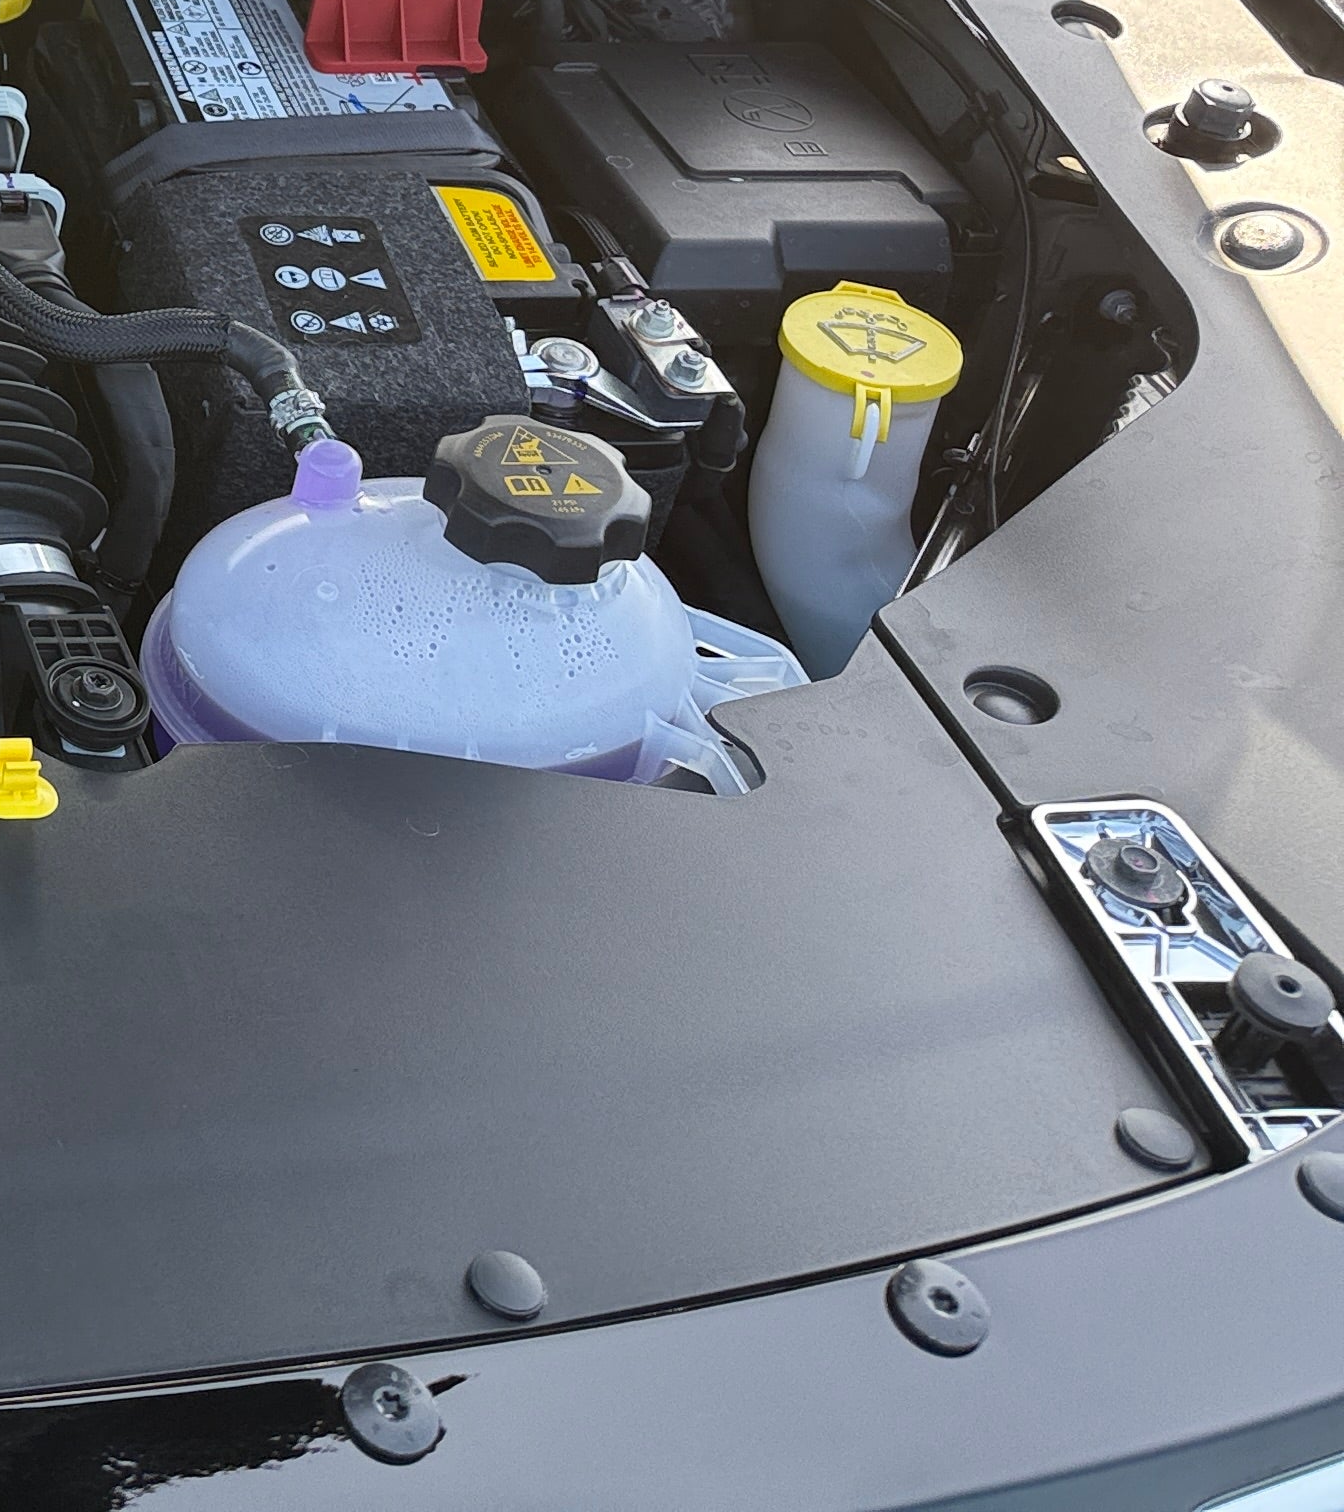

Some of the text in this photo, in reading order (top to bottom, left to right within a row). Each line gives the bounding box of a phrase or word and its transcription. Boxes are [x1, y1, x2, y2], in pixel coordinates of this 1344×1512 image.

[453, 198, 475, 226] BATTERY
[482, 209, 517, 260] NON-SPILLABLE
[482, 231, 495, 244] NOT
[477, 243, 498, 267] SEALED
